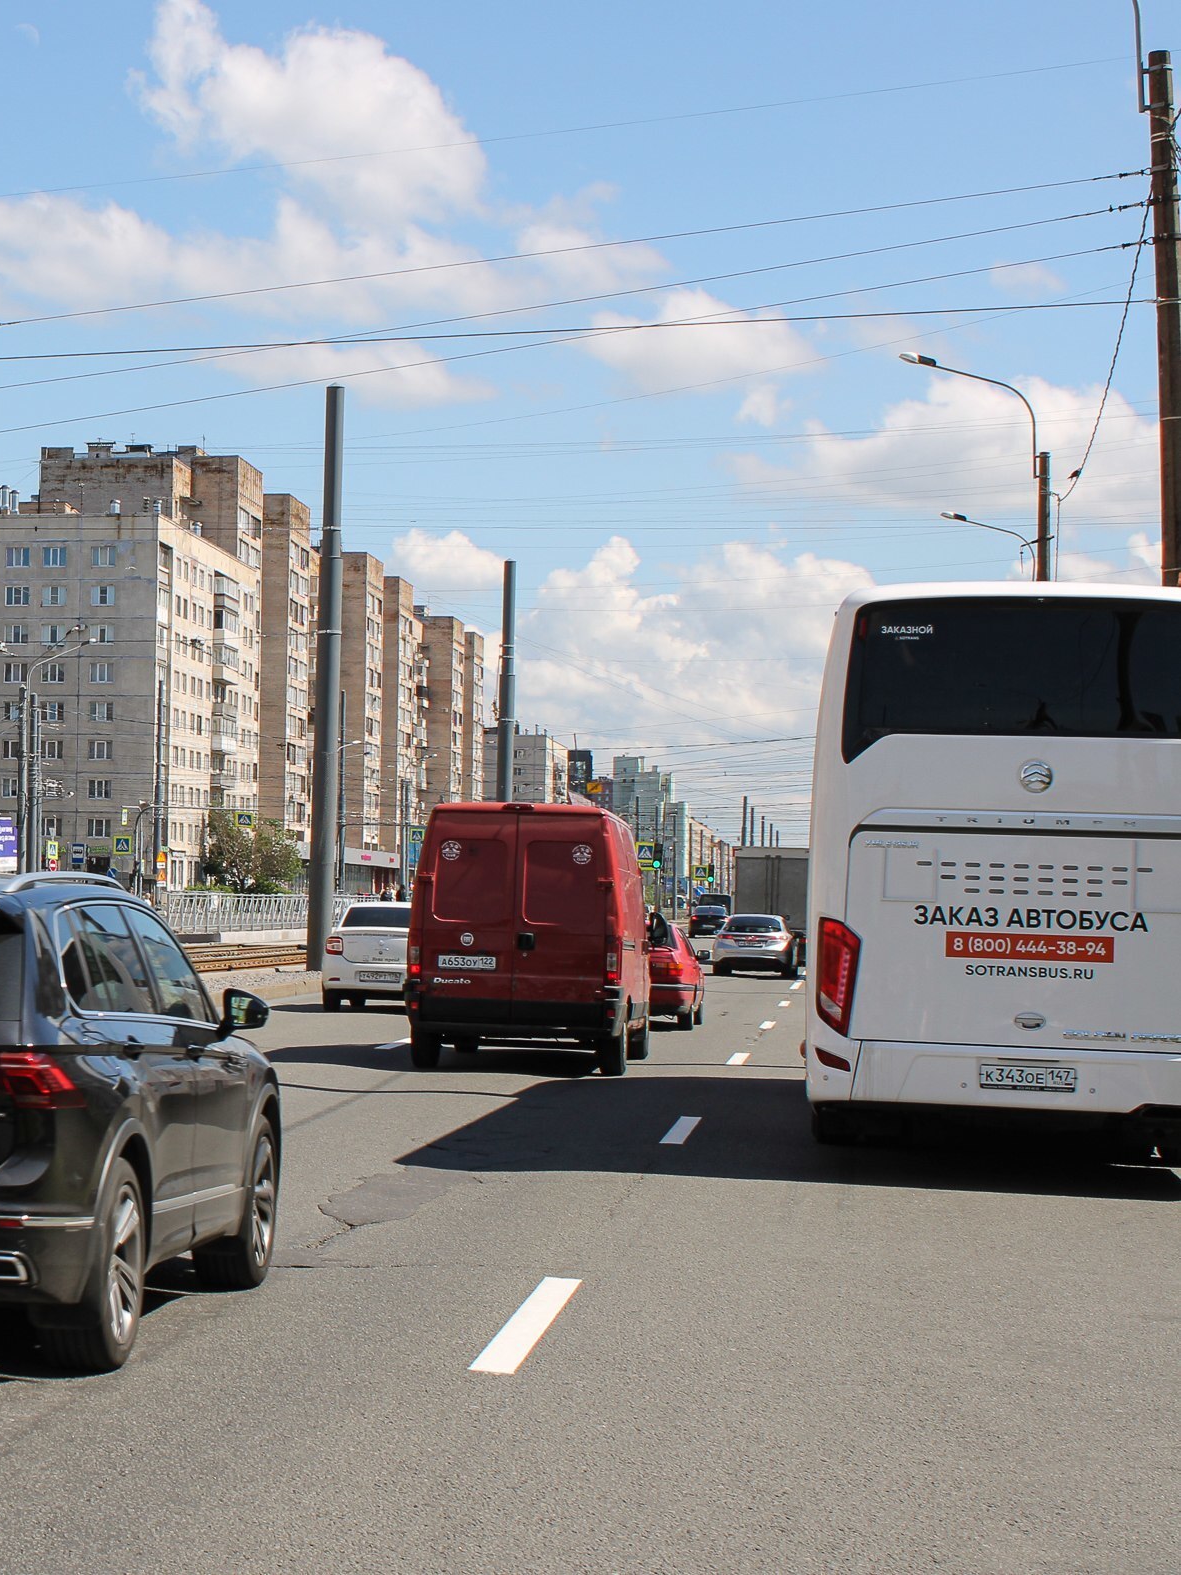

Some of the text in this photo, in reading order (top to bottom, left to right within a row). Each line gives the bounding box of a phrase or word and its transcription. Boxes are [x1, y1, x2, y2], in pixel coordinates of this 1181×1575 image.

[881, 624, 933, 634] ЗАКАЗНОЙ
[914, 905, 1149, 933] ЗАКАЗ АВТОБУСА
[953, 937, 1106, 956] 8 (800) 444-38-94
[965, 964, 1094, 980] SOTRANSBUS.RU
[985, 1068, 1071, 1085] К343ОЕ 147
